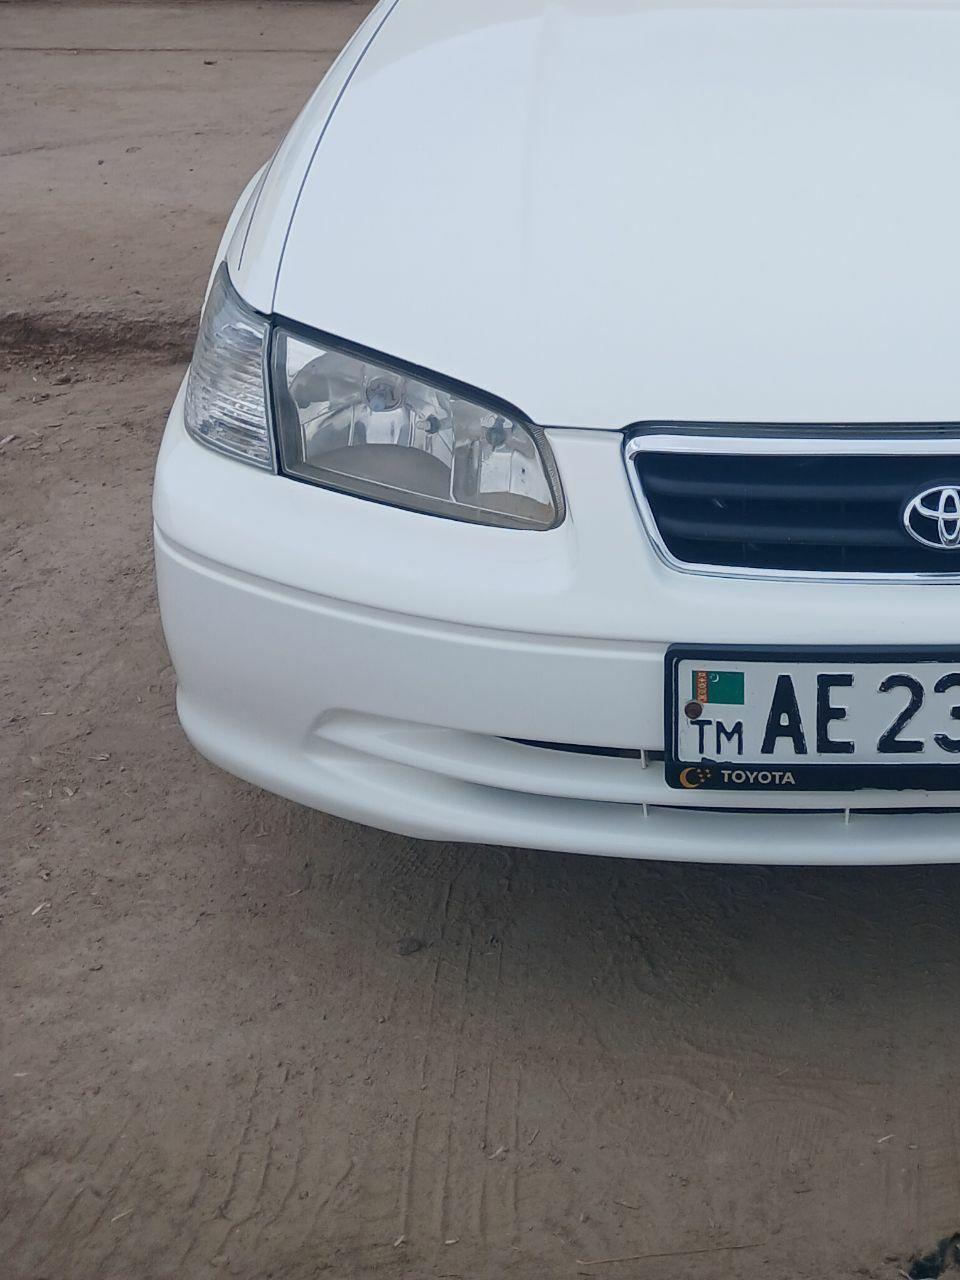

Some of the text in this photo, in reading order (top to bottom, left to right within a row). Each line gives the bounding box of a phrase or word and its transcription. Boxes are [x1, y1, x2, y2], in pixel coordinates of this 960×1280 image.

[761, 672, 855, 754] AE
[690, 719, 745, 755] TM
[721, 770, 796, 785] TOYOTA
